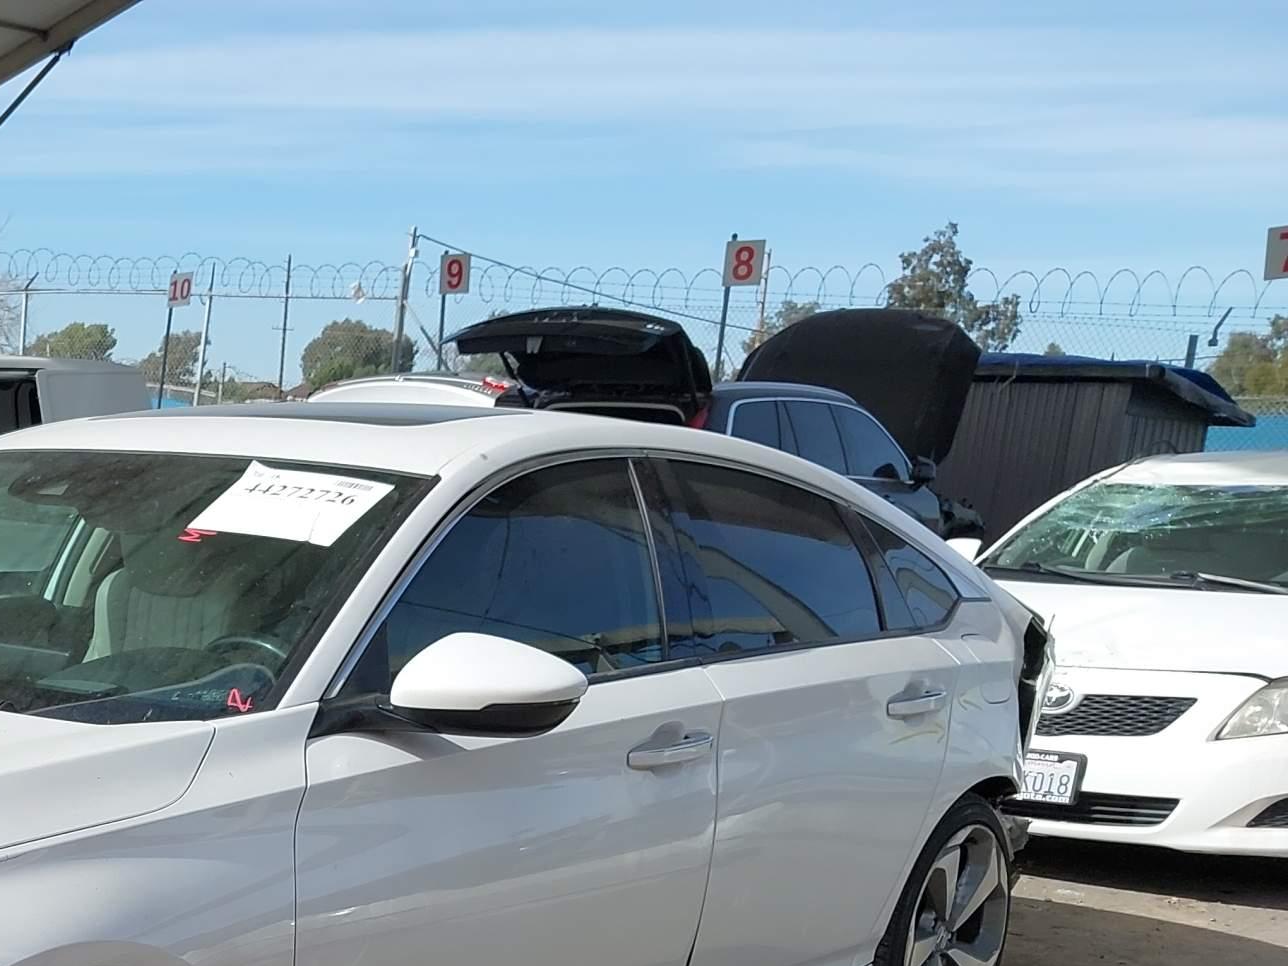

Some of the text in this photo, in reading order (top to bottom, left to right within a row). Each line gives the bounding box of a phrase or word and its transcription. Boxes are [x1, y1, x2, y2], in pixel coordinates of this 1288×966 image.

[447, 259, 463, 289] 9
[732, 245, 755, 281] 8
[169, 278, 191, 302] 10
[244, 482, 356, 507] 44272726
